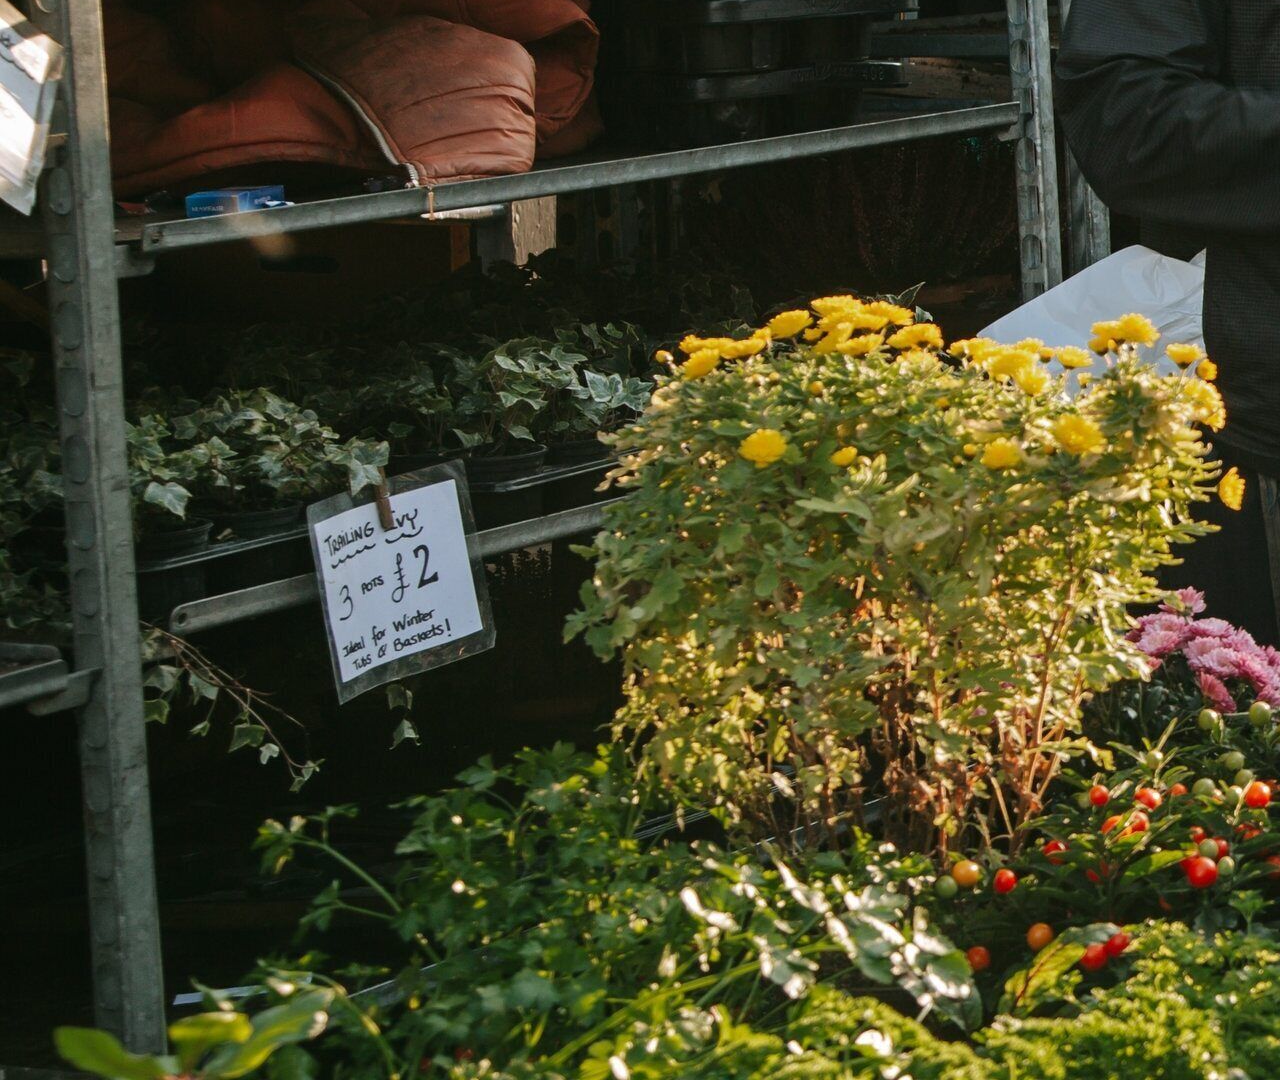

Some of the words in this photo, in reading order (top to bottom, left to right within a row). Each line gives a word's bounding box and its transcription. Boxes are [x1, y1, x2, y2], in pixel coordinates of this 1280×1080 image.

[339, 584, 354, 622] 3
[343, 635, 365, 658] Ideal
[372, 624, 387, 647] for
[392, 607, 436, 632] Winter
[352, 652, 372, 671] Tubs
